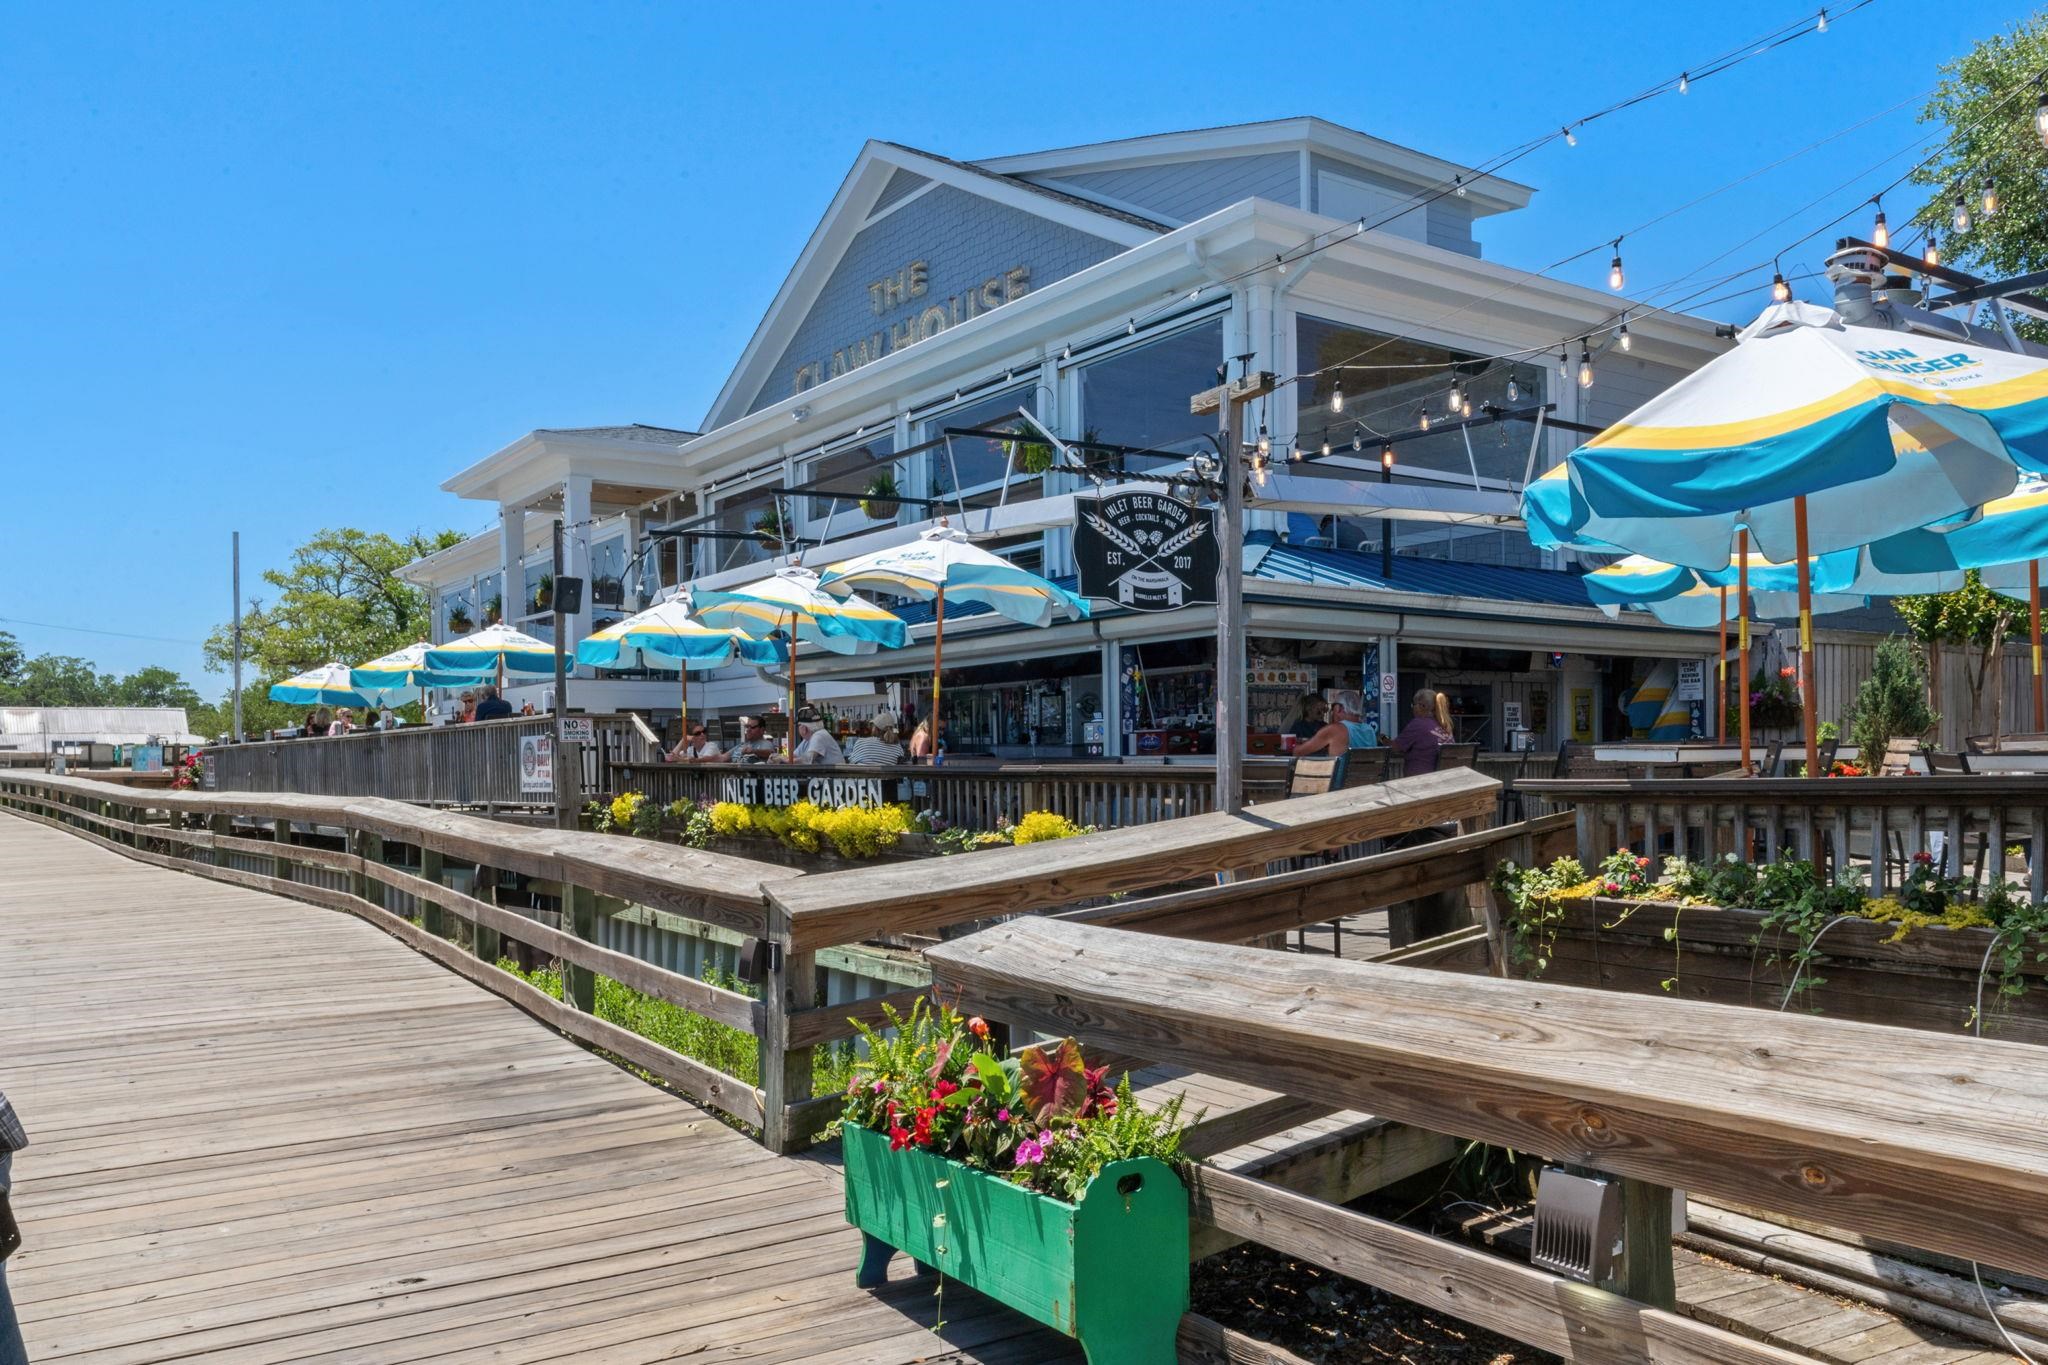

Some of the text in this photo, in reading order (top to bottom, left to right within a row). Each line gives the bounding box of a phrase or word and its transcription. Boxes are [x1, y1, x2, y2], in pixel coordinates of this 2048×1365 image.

[868, 260, 928, 316] THE
[889, 265, 1031, 351] HOUSE
[1855, 348, 1918, 361] SUN
[1105, 496, 1189, 525] INLET BEER GARDEN
[1118, 513, 1178, 531] BEER COCKTAILS WINE
[1107, 552, 1192, 569] EST. 2017
[563, 720, 579, 729] NO
[537, 738, 550, 752] OPEN
[537, 753, 550, 767] DAILY
[722, 777, 883, 810] INLET BEER GARDEN
